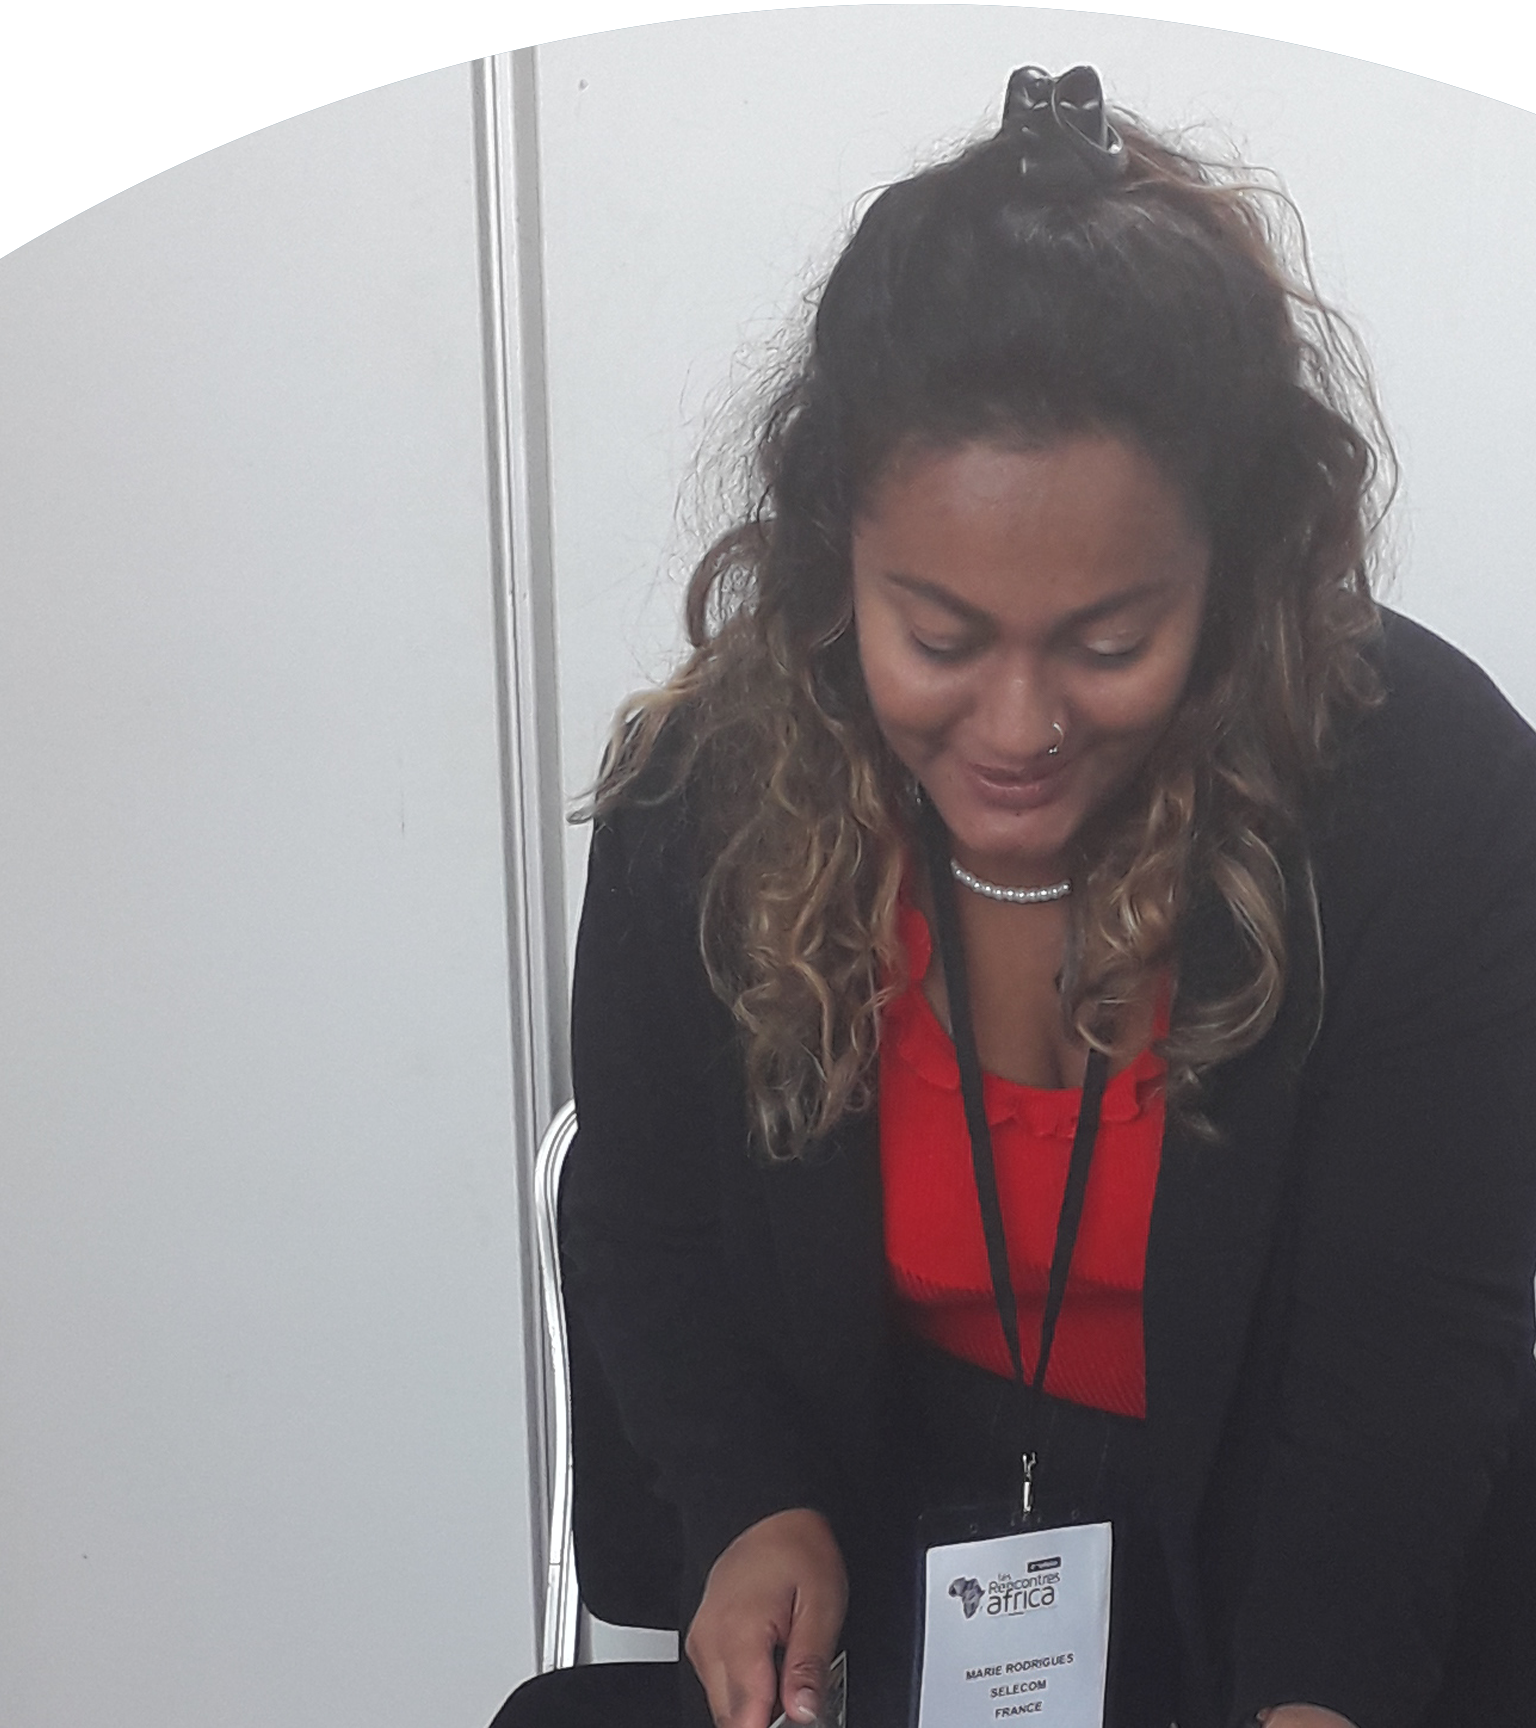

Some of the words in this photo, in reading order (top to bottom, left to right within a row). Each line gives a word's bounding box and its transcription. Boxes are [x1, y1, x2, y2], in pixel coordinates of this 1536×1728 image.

[989, 1572, 1061, 1594] Rencontres
[987, 1586, 1055, 1615] africa
[966, 1665, 1002, 1680] MARIE
[1006, 1653, 1074, 1674] RODRIGUES
[990, 1679, 1047, 1698] SELECOM
[995, 1701, 1043, 1718] FRANCE
